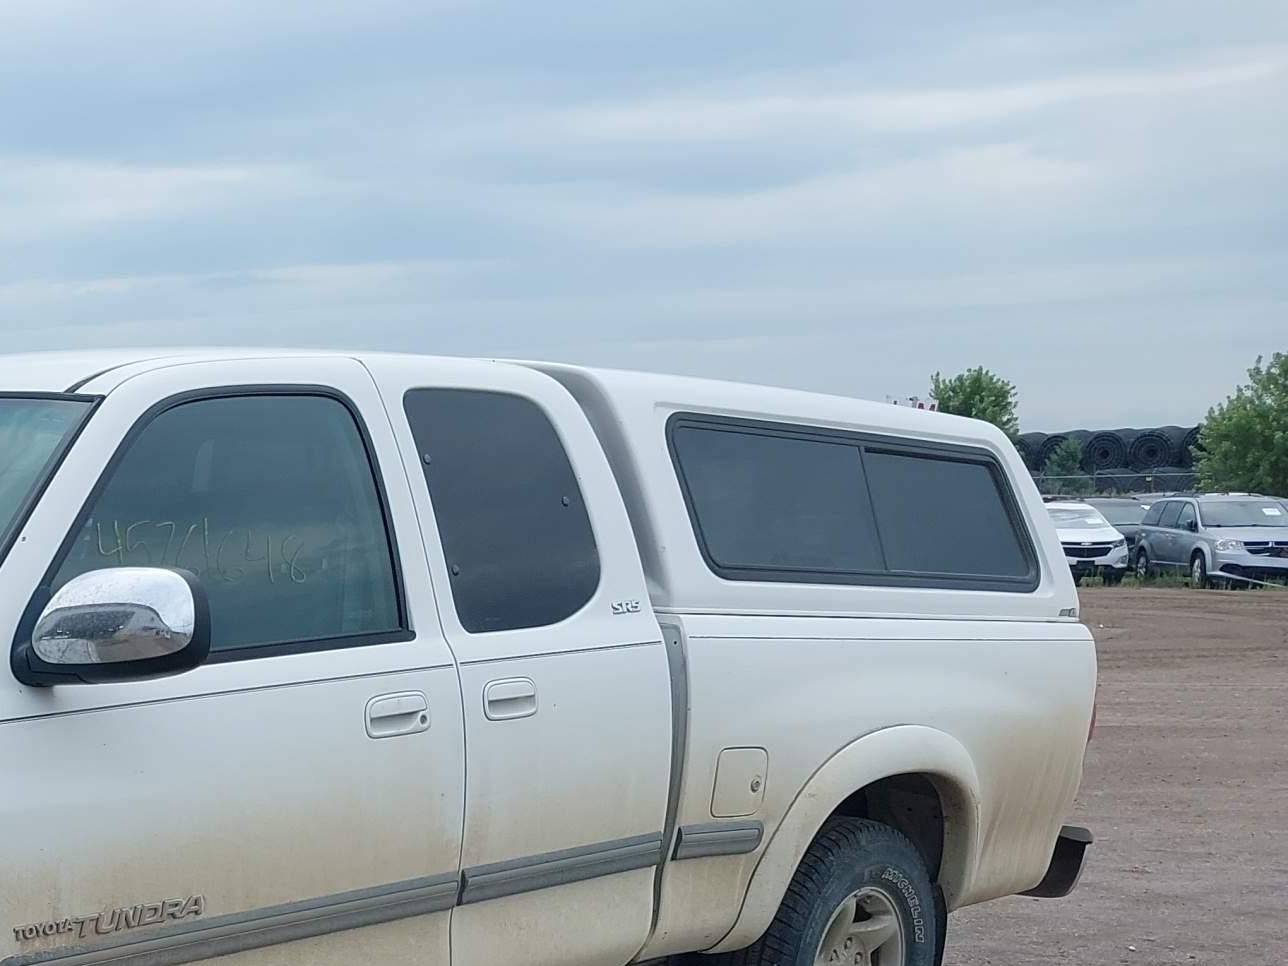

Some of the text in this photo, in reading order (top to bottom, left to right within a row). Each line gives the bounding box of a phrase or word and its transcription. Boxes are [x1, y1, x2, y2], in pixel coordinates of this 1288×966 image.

[13, 894, 206, 942] TOYOTA TUNDRA
[882, 867, 924, 943] MICHELIN
